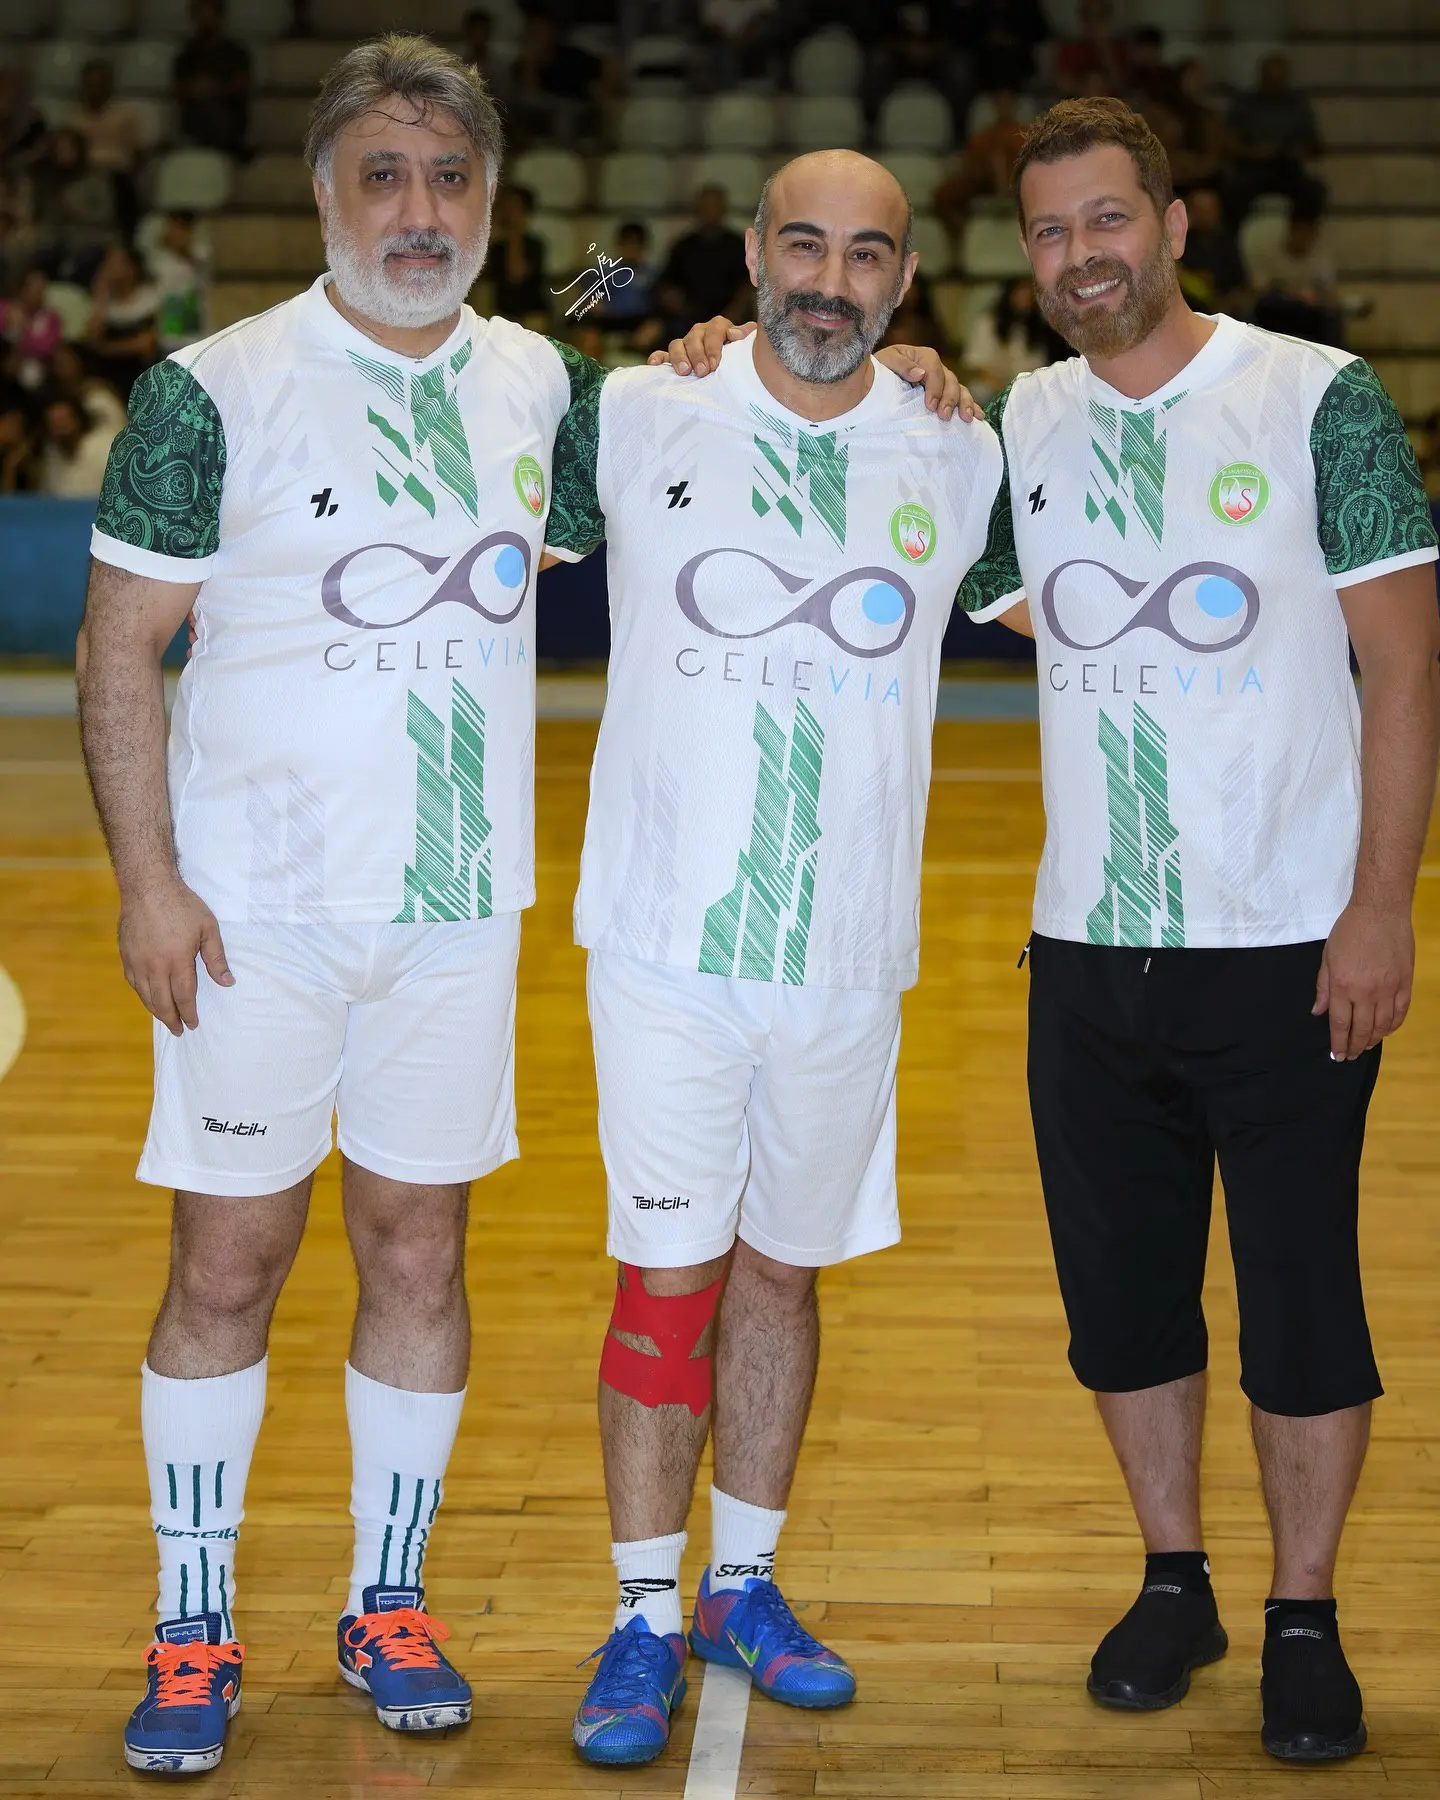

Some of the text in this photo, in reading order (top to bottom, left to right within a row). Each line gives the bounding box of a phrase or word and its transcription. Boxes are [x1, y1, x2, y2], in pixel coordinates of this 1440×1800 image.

[324, 636, 527, 671] CELEVIA
[676, 647, 901, 706] CELEVIA
[1049, 663, 1263, 695] CELEVIA
[201, 1116, 268, 1136] Taktik
[632, 1195, 690, 1210] Taktik
[1144, 1584, 1181, 1594] KECHERS
